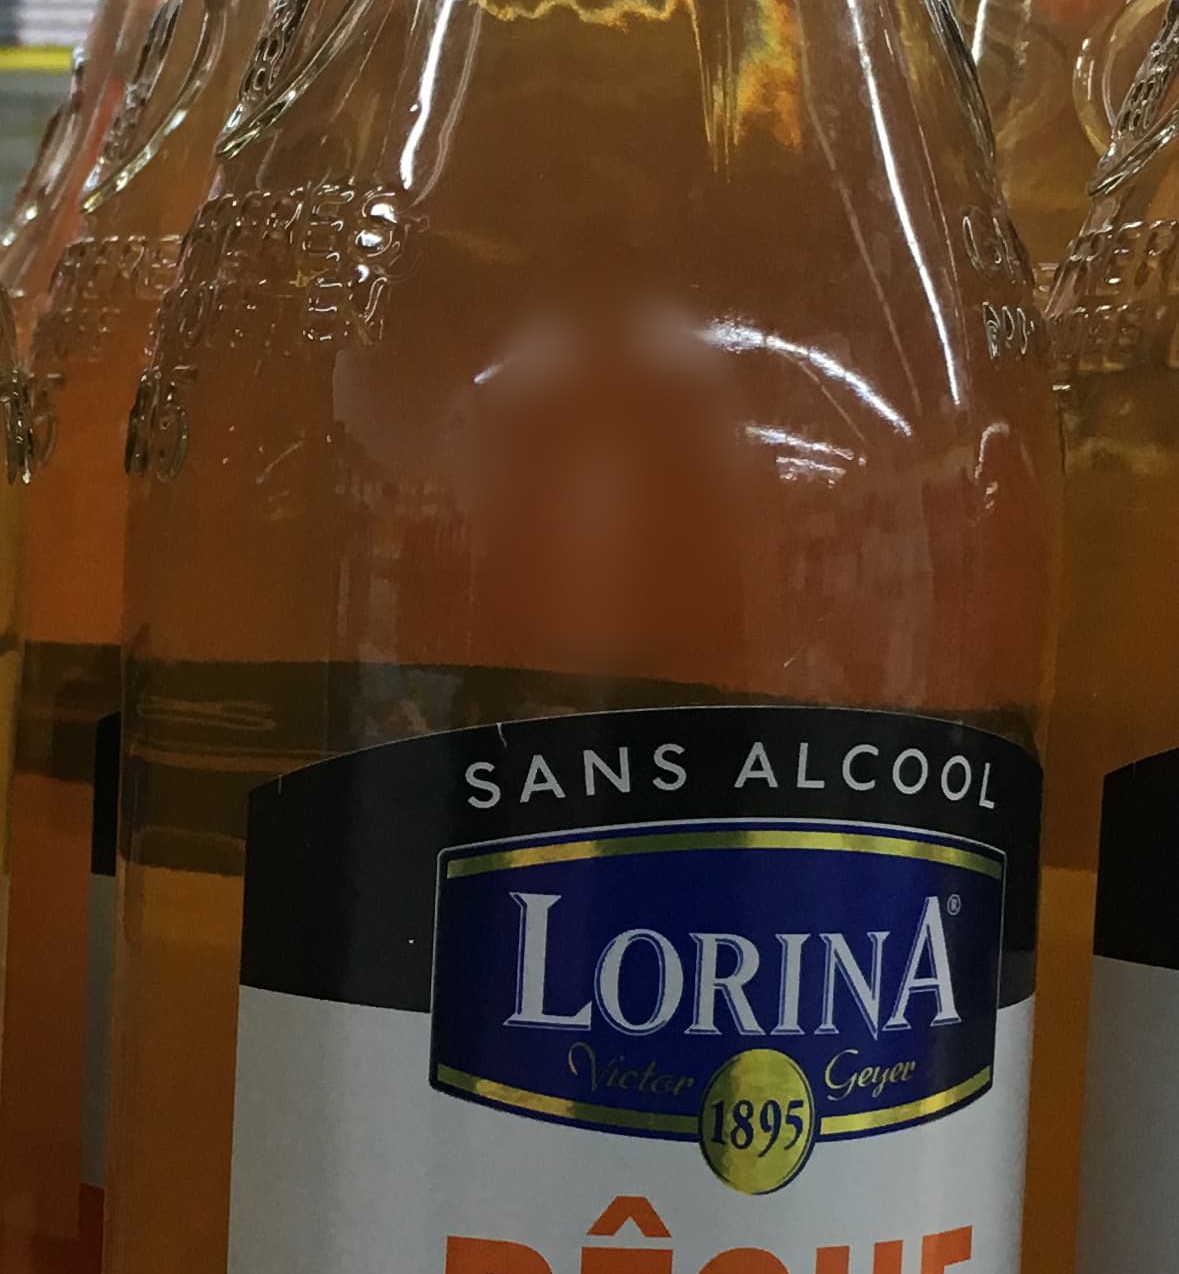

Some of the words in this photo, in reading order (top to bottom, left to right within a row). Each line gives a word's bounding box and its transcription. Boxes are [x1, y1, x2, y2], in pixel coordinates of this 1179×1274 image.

[465, 743, 688, 809] SANS
[733, 741, 997, 811] ALCOOL
[502, 890, 963, 1042] LORINA
[567, 1041, 695, 1096] Victor
[824, 1048, 917, 1102] Geyer
[710, 1098, 805, 1158] 1895
